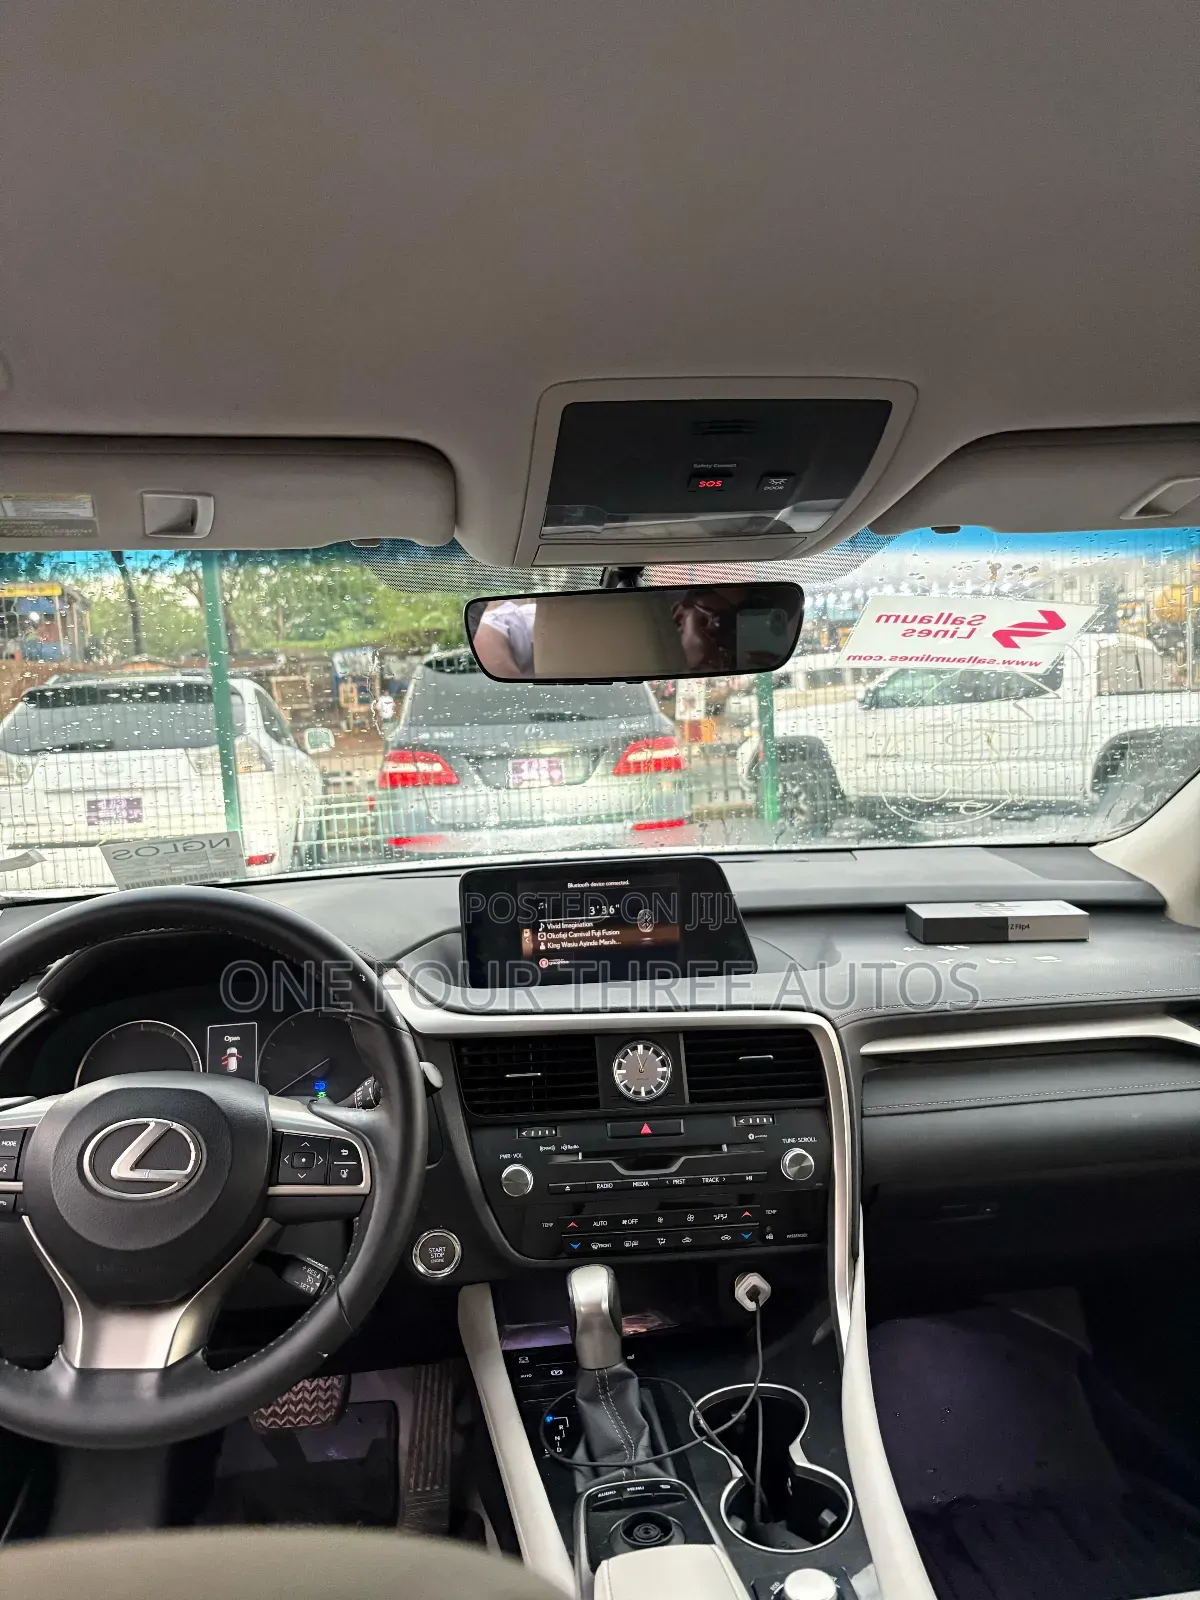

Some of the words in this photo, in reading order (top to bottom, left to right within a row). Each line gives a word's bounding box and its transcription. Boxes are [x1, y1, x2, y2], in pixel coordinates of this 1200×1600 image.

[699, 480, 723, 488] SOS
[561, 921, 594, 930] Imagination
[1015, 922, 1031, 931] Flip4
[568, 930, 591, 938] Carnival
[602, 928, 621, 936] Fusion
[547, 942, 561, 950] King
[579, 940, 599, 948] Ayinde
[632, 1180, 650, 1188] MEDIA
